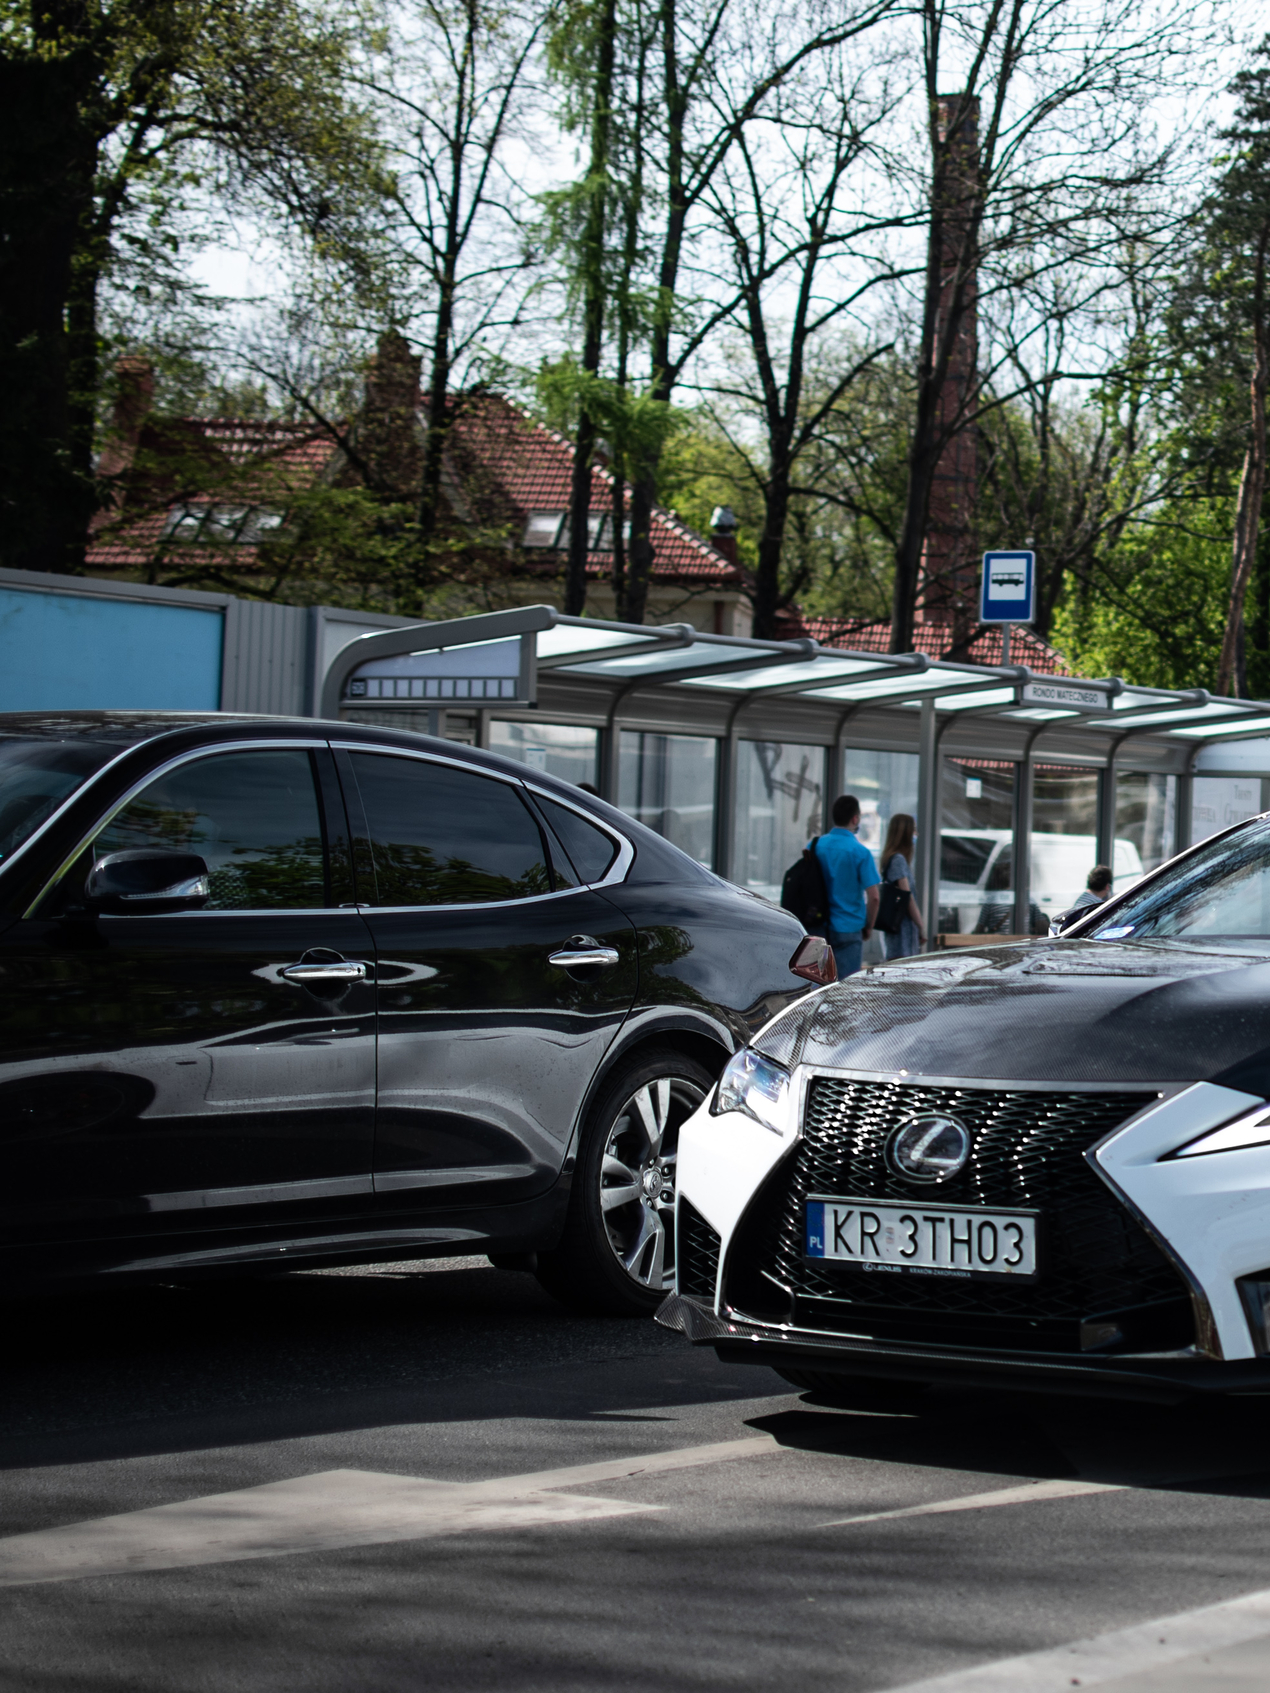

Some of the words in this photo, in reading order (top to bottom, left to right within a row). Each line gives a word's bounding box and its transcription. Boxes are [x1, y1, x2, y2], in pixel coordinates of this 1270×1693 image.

[1032, 687, 1055, 698] RONDO
[1057, 690, 1098, 703] MATECZNEGO
[810, 1235, 823, 1249] PL
[833, 1209, 880, 1256] KR
[899, 1214, 1024, 1267] 3TH03
[873, 1264, 902, 1272] LEXUS
